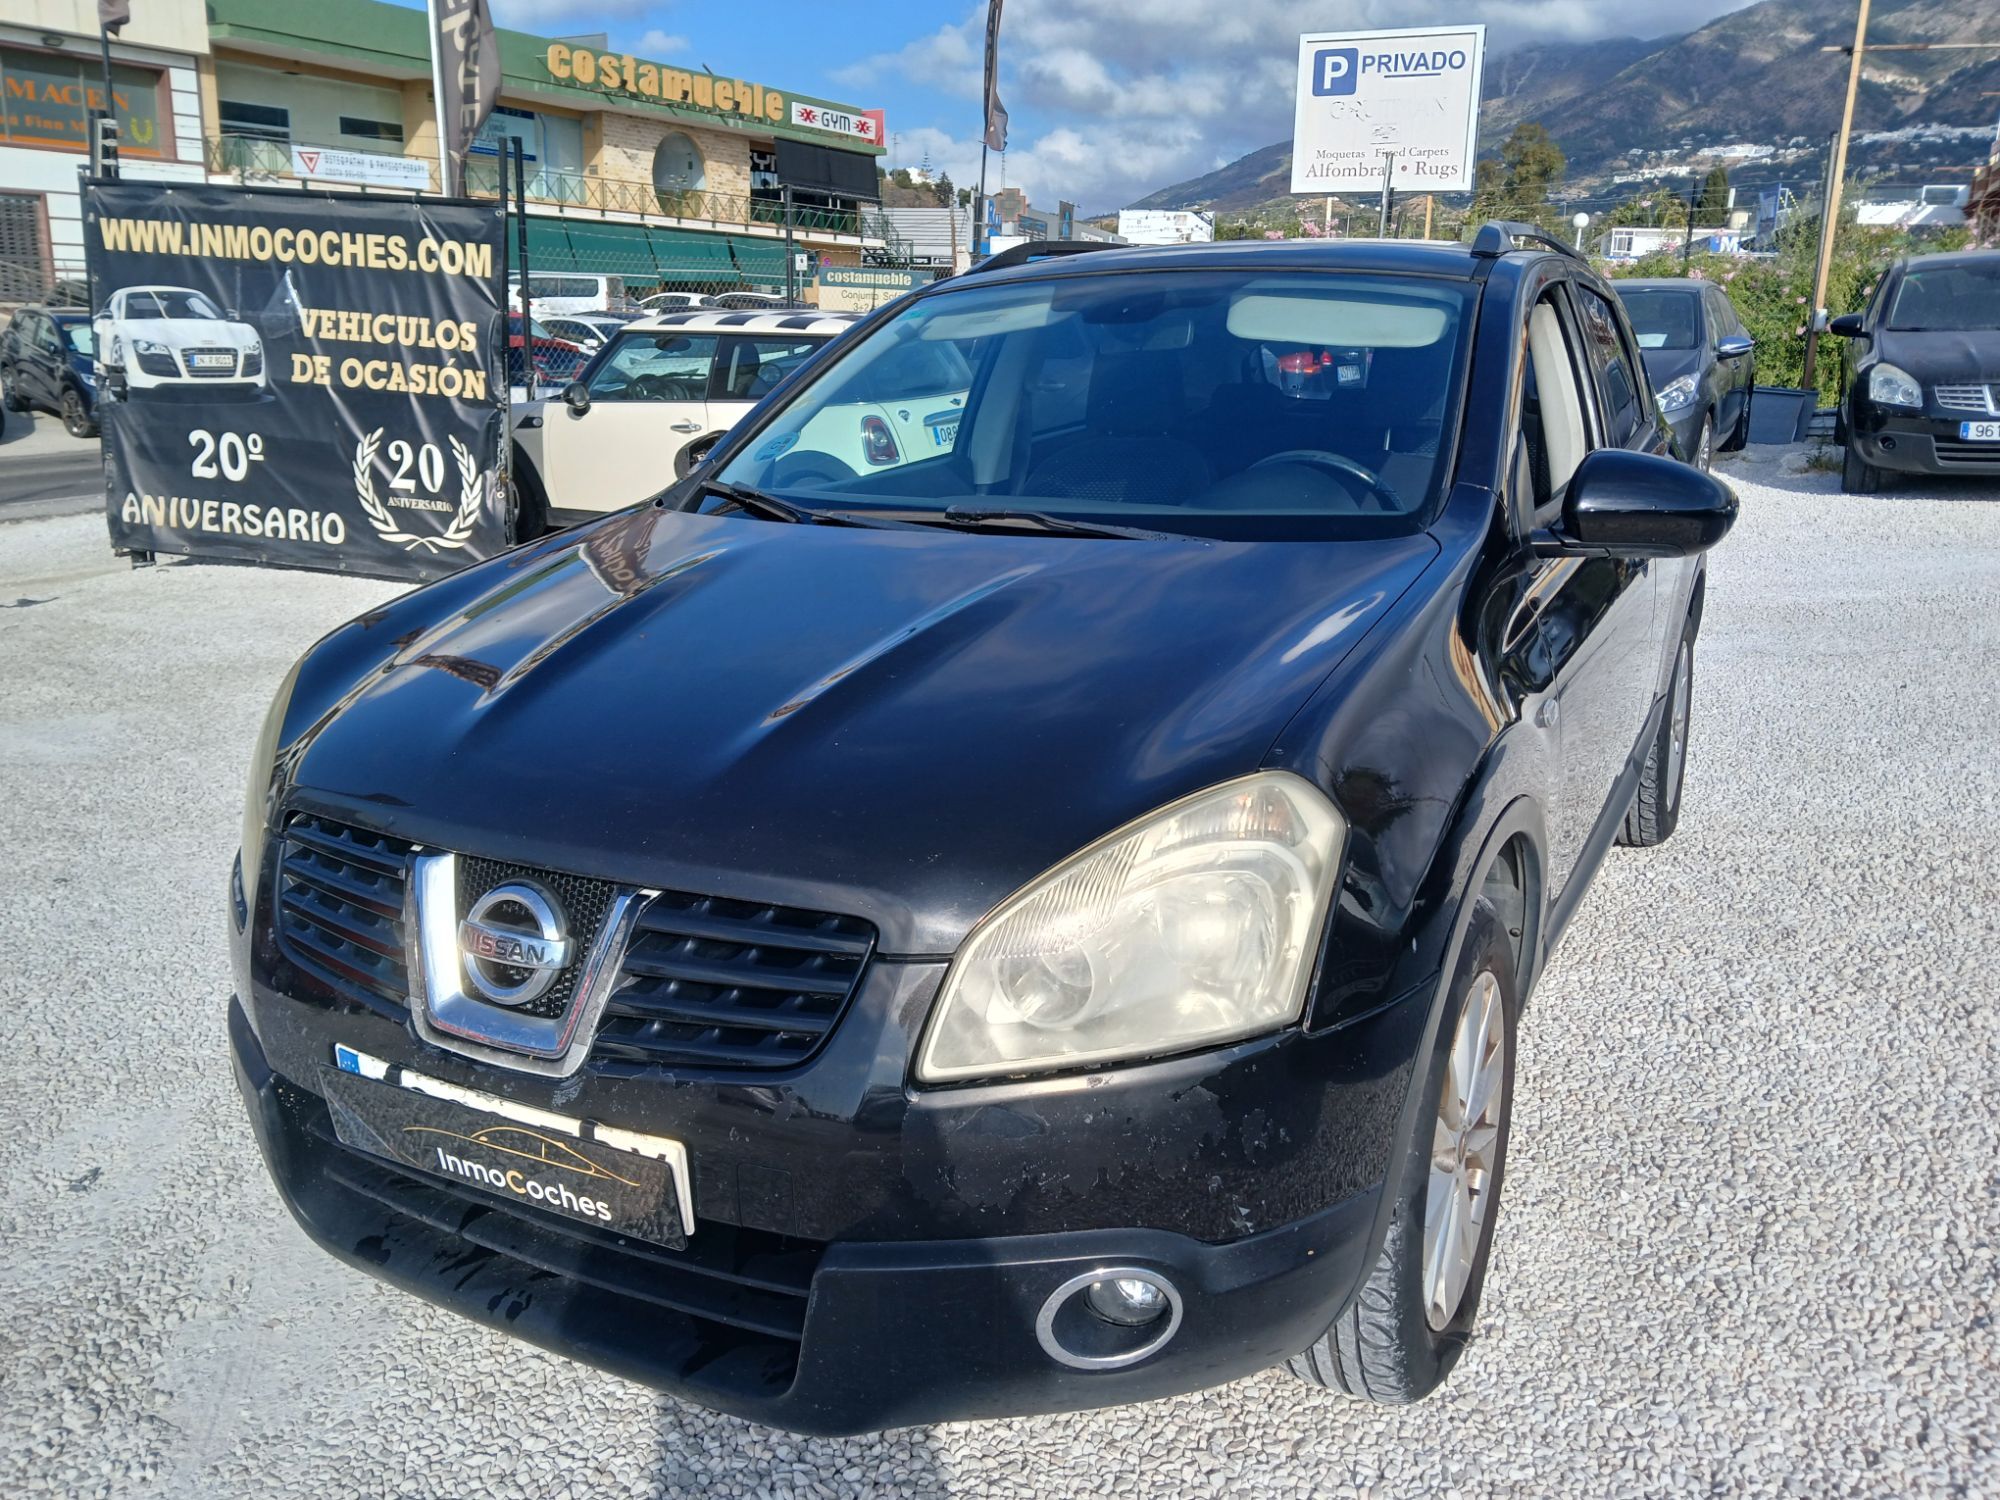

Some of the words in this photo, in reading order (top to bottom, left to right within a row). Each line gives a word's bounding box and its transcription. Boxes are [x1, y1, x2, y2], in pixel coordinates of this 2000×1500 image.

[547, 44, 783, 121] costamueble
[1361, 50, 1466, 74] PRIVADO
[821, 112, 850, 132] GYM
[1305, 162, 1392, 178] Alfombra
[1415, 161, 1458, 179] Rugs
[1316, 150, 1366, 161] Moquetas
[1409, 147, 1449, 157] Carpets
[99, 217, 492, 278] WWW.INMOCOCHES.COM
[826, 272, 912, 286] costamueble
[300, 308, 477, 352] VEHICULOS
[290, 353, 332, 385] DE
[340, 357, 486, 400] OCASIÓN
[388, 439, 445, 493] 20
[121, 492, 345, 545] ANIVERSARIO
[387, 496, 454, 513] ANIVERSARIO
[464, 925, 546, 964] NISSAN
[436, 1147, 613, 1222] InmoCoches
